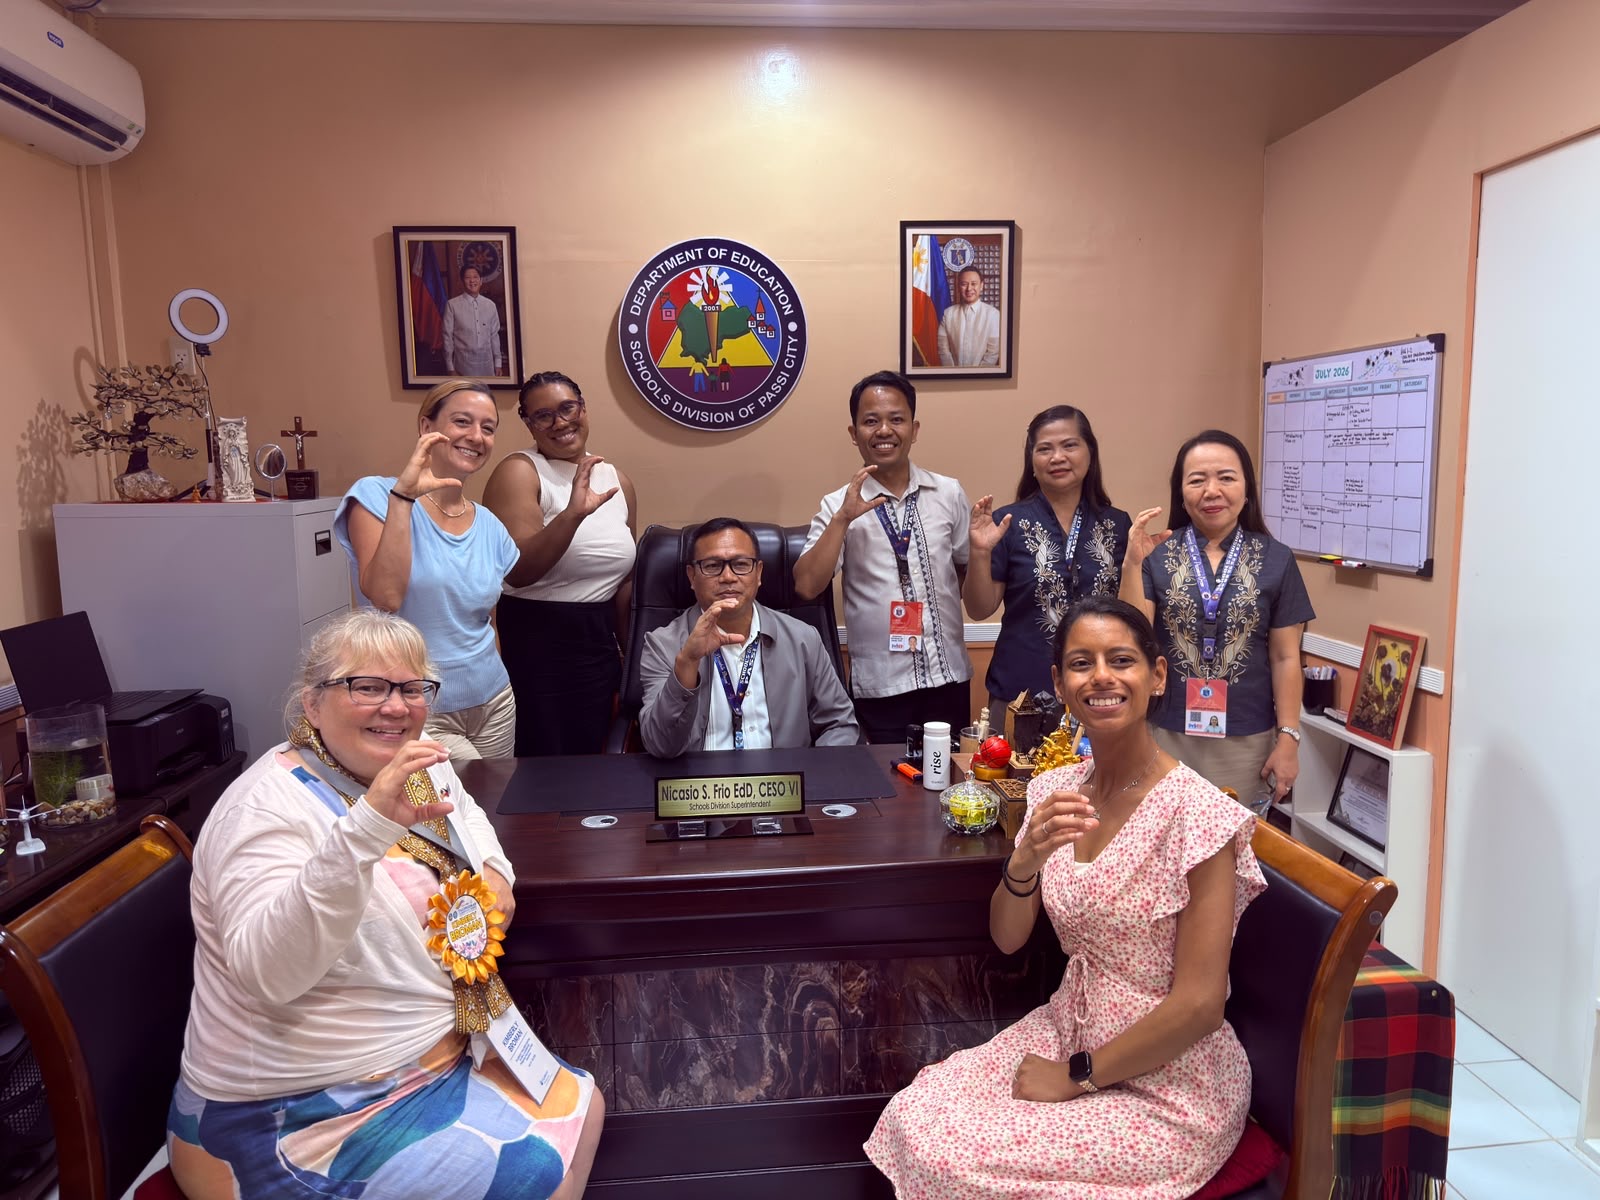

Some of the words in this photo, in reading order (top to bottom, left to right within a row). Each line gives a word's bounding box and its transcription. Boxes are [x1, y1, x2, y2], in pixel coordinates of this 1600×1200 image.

[629, 247, 704, 317] DEPARTMENT
[707, 247, 728, 259] OF
[730, 250, 794, 316] EDUCATION
[629, 340, 672, 406] SCHOOLS
[671, 401, 735, 423] DIVISION
[738, 404, 757, 419] OF
[758, 374, 791, 408] PASSI
[784, 335, 799, 370] CITY
[1314, 367, 1332, 380] JULY
[1333, 366, 1350, 378] 2026
[739, 653, 751, 685] SCHOOLS
[744, 648, 757, 685] PASSI
[930, 751, 942, 775] rise
[661, 785, 700, 801] Nicasio
[701, 784, 711, 800] S.
[713, 783, 731, 799] Frio
[733, 782, 756, 799] EdD,
[758, 781, 786, 797] CESO
[788, 780, 799, 797] VI
[688, 802, 710, 811] Schools
[710, 801, 730, 810] Division
[730, 799, 772, 810] Superintendent
[449, 917, 484, 943] BROMAN
[451, 910, 477, 929] KIMBERLY
[502, 1020, 519, 1047] KIMBERLY
[507, 1028, 524, 1053] BROMAN
